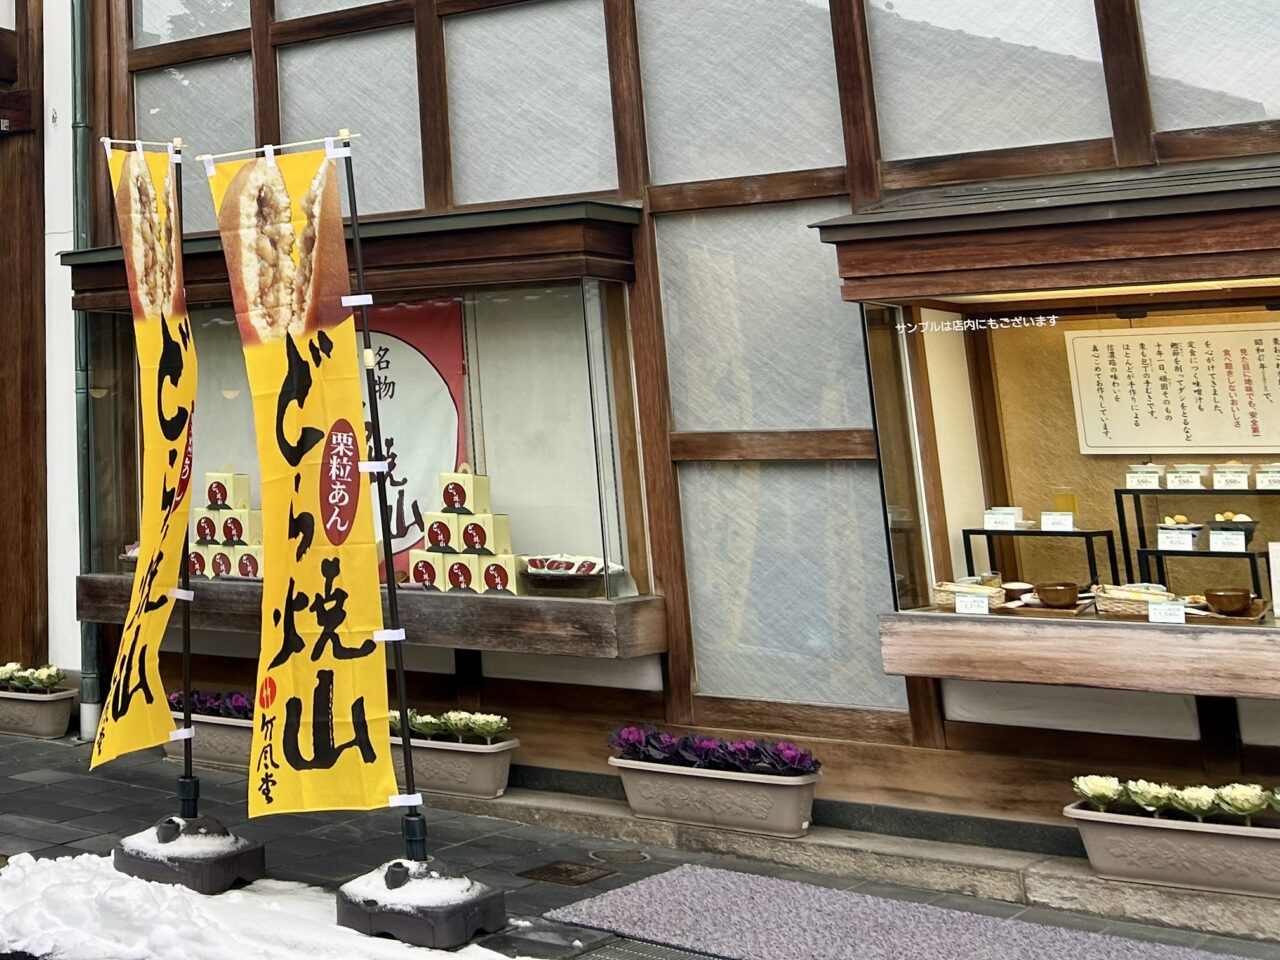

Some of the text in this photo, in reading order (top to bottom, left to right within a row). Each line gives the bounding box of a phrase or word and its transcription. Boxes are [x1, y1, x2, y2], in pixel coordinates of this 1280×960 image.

[895, 314, 1060, 334] サンプルは店内にもございます
[374, 346, 396, 401] 名物
[325, 431, 356, 532] 栗粒あん
[267, 330, 377, 772] どら焼山
[256, 712, 281, 805] 竹風堂
